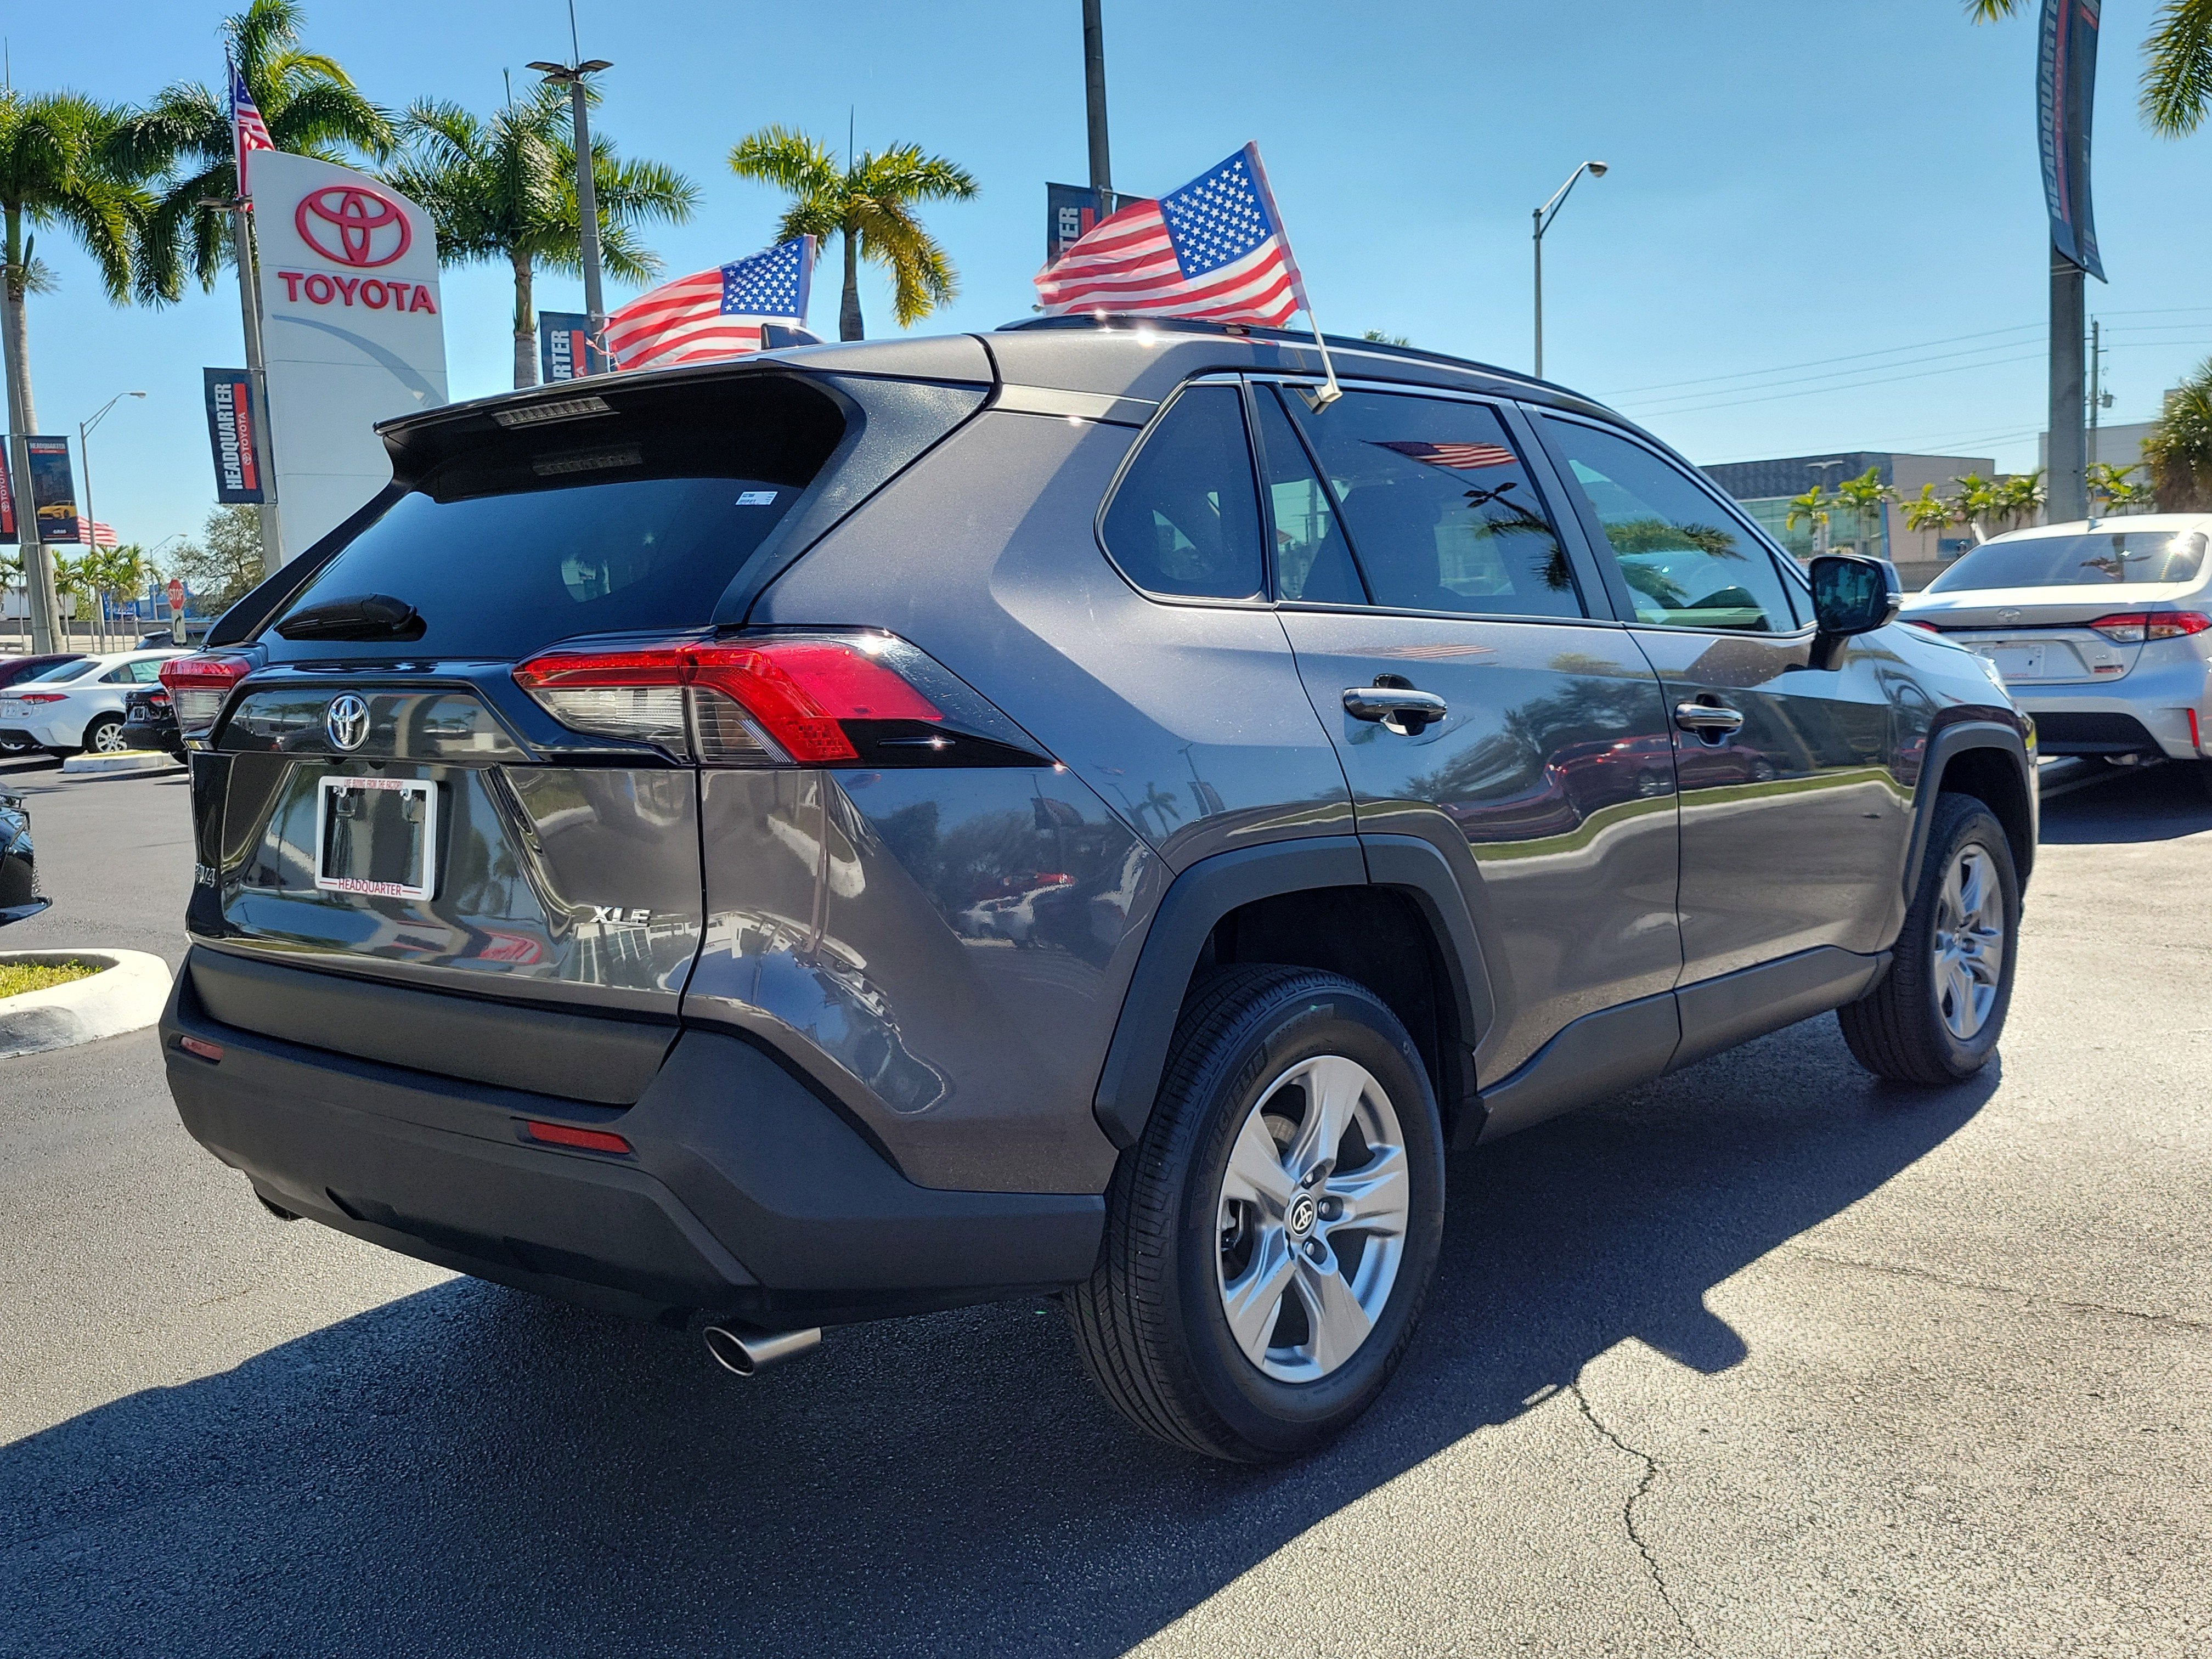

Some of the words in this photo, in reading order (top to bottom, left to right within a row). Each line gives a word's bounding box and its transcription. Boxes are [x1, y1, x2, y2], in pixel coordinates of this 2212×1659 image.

[277, 270, 437, 315] TOYOTA
[215, 383, 244, 490] HEADQUARTER
[238, 412, 251, 451] TOYOTA
[169, 589, 183, 600] STOP
[338, 878, 402, 896] HEADQUARTER
[590, 906, 651, 927] XLE
